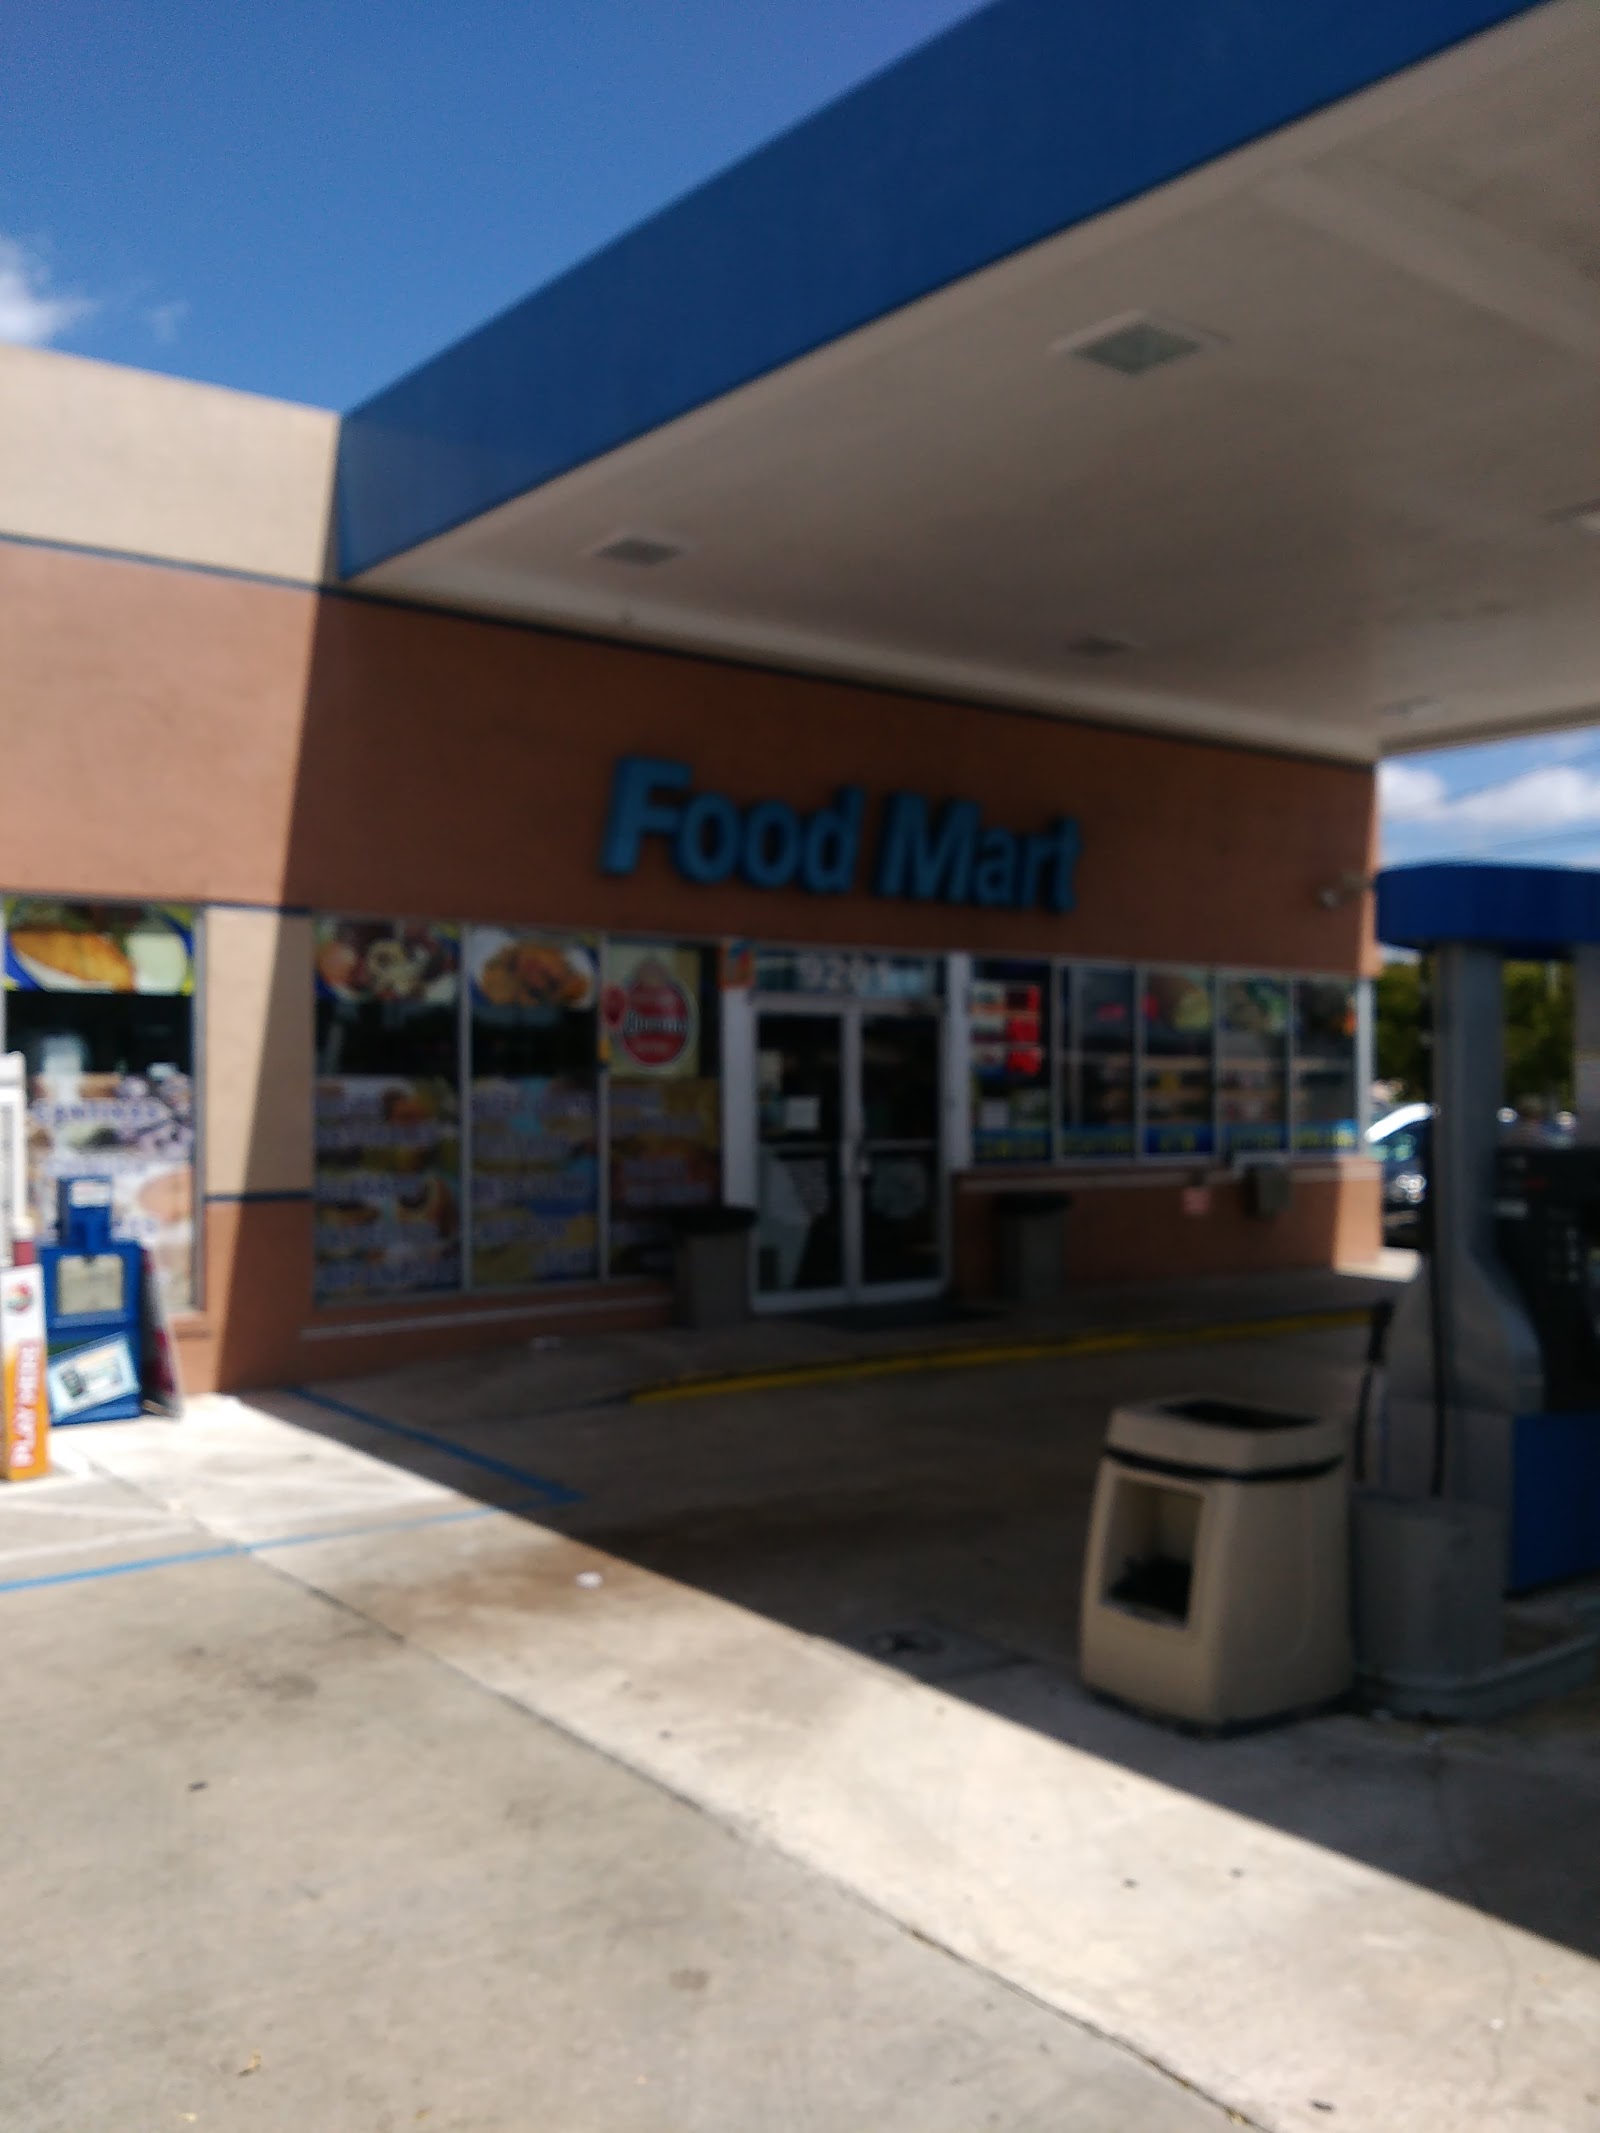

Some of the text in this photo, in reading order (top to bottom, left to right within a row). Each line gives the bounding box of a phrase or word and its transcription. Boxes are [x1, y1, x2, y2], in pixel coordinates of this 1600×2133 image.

[600, 755, 1082, 914] Food Mart
[9, 1405, 37, 1469] PLAY
